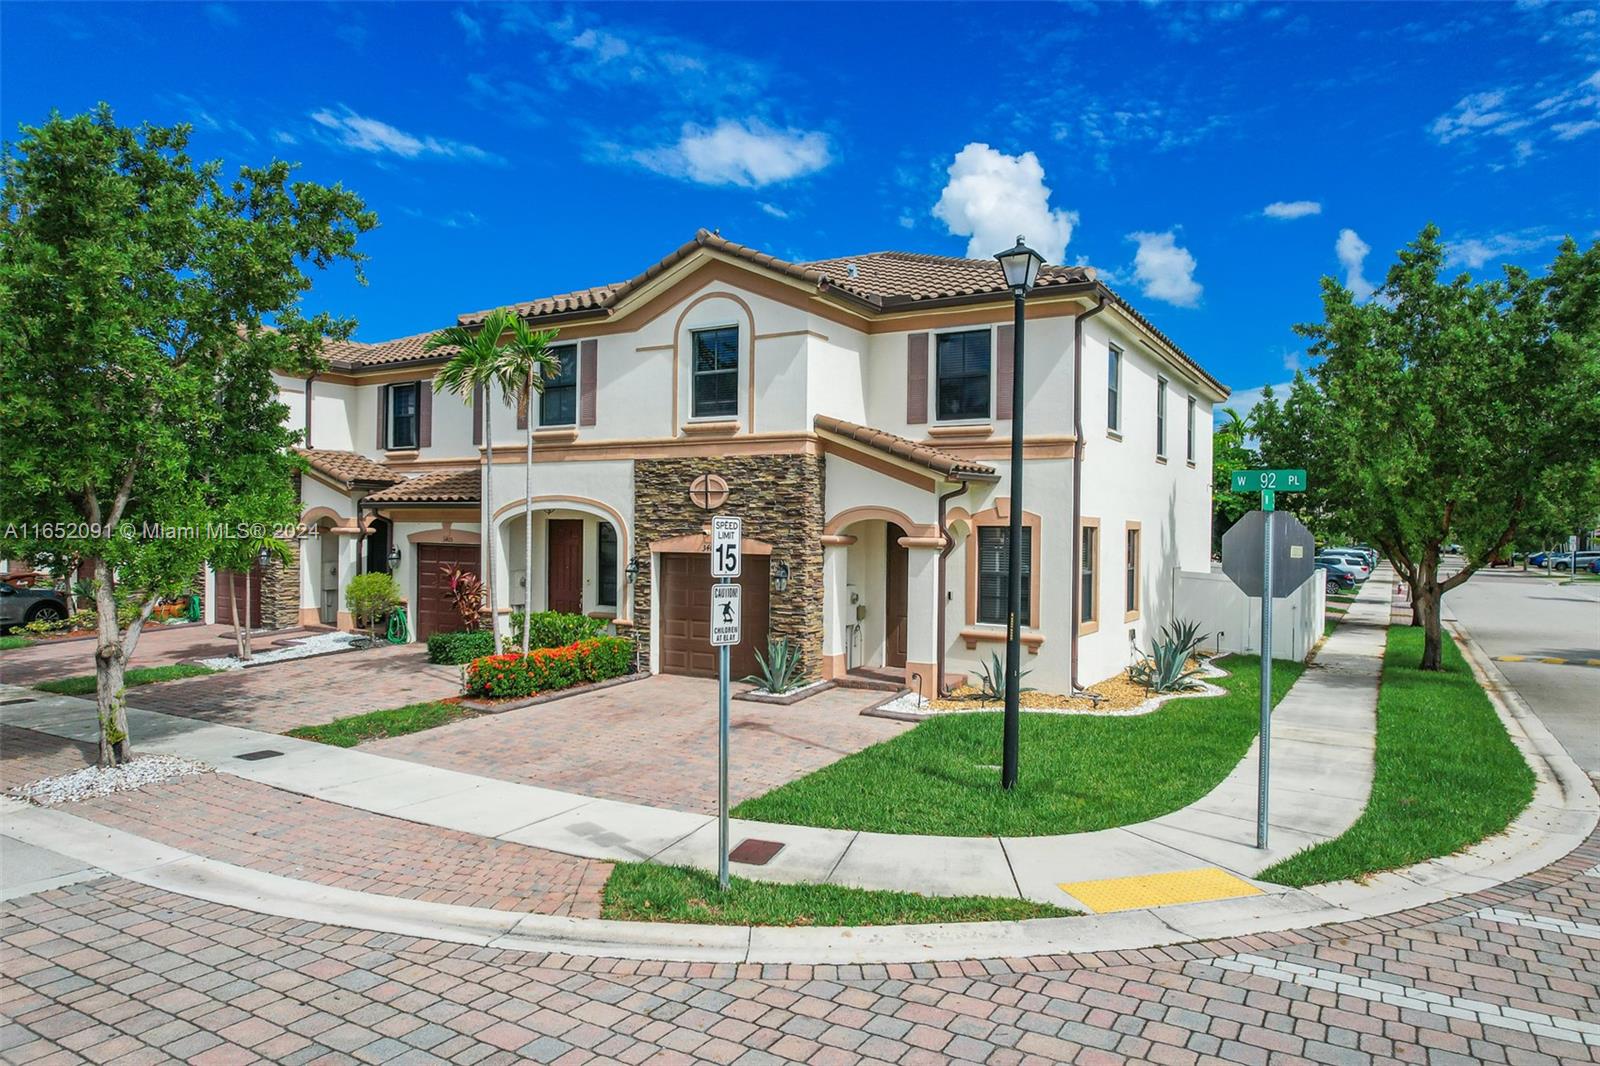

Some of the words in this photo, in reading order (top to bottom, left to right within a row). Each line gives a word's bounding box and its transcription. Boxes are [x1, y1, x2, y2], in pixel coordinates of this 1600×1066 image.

[1237, 476, 1246, 486] W
[1260, 472, 1276, 488] 92
[1288, 475, 1300, 486] PL
[716, 522, 738, 530] SPEED
[717, 532, 735, 540] LIMIT
[716, 543, 737, 571] 15
[714, 626, 738, 634] CHILDREN
